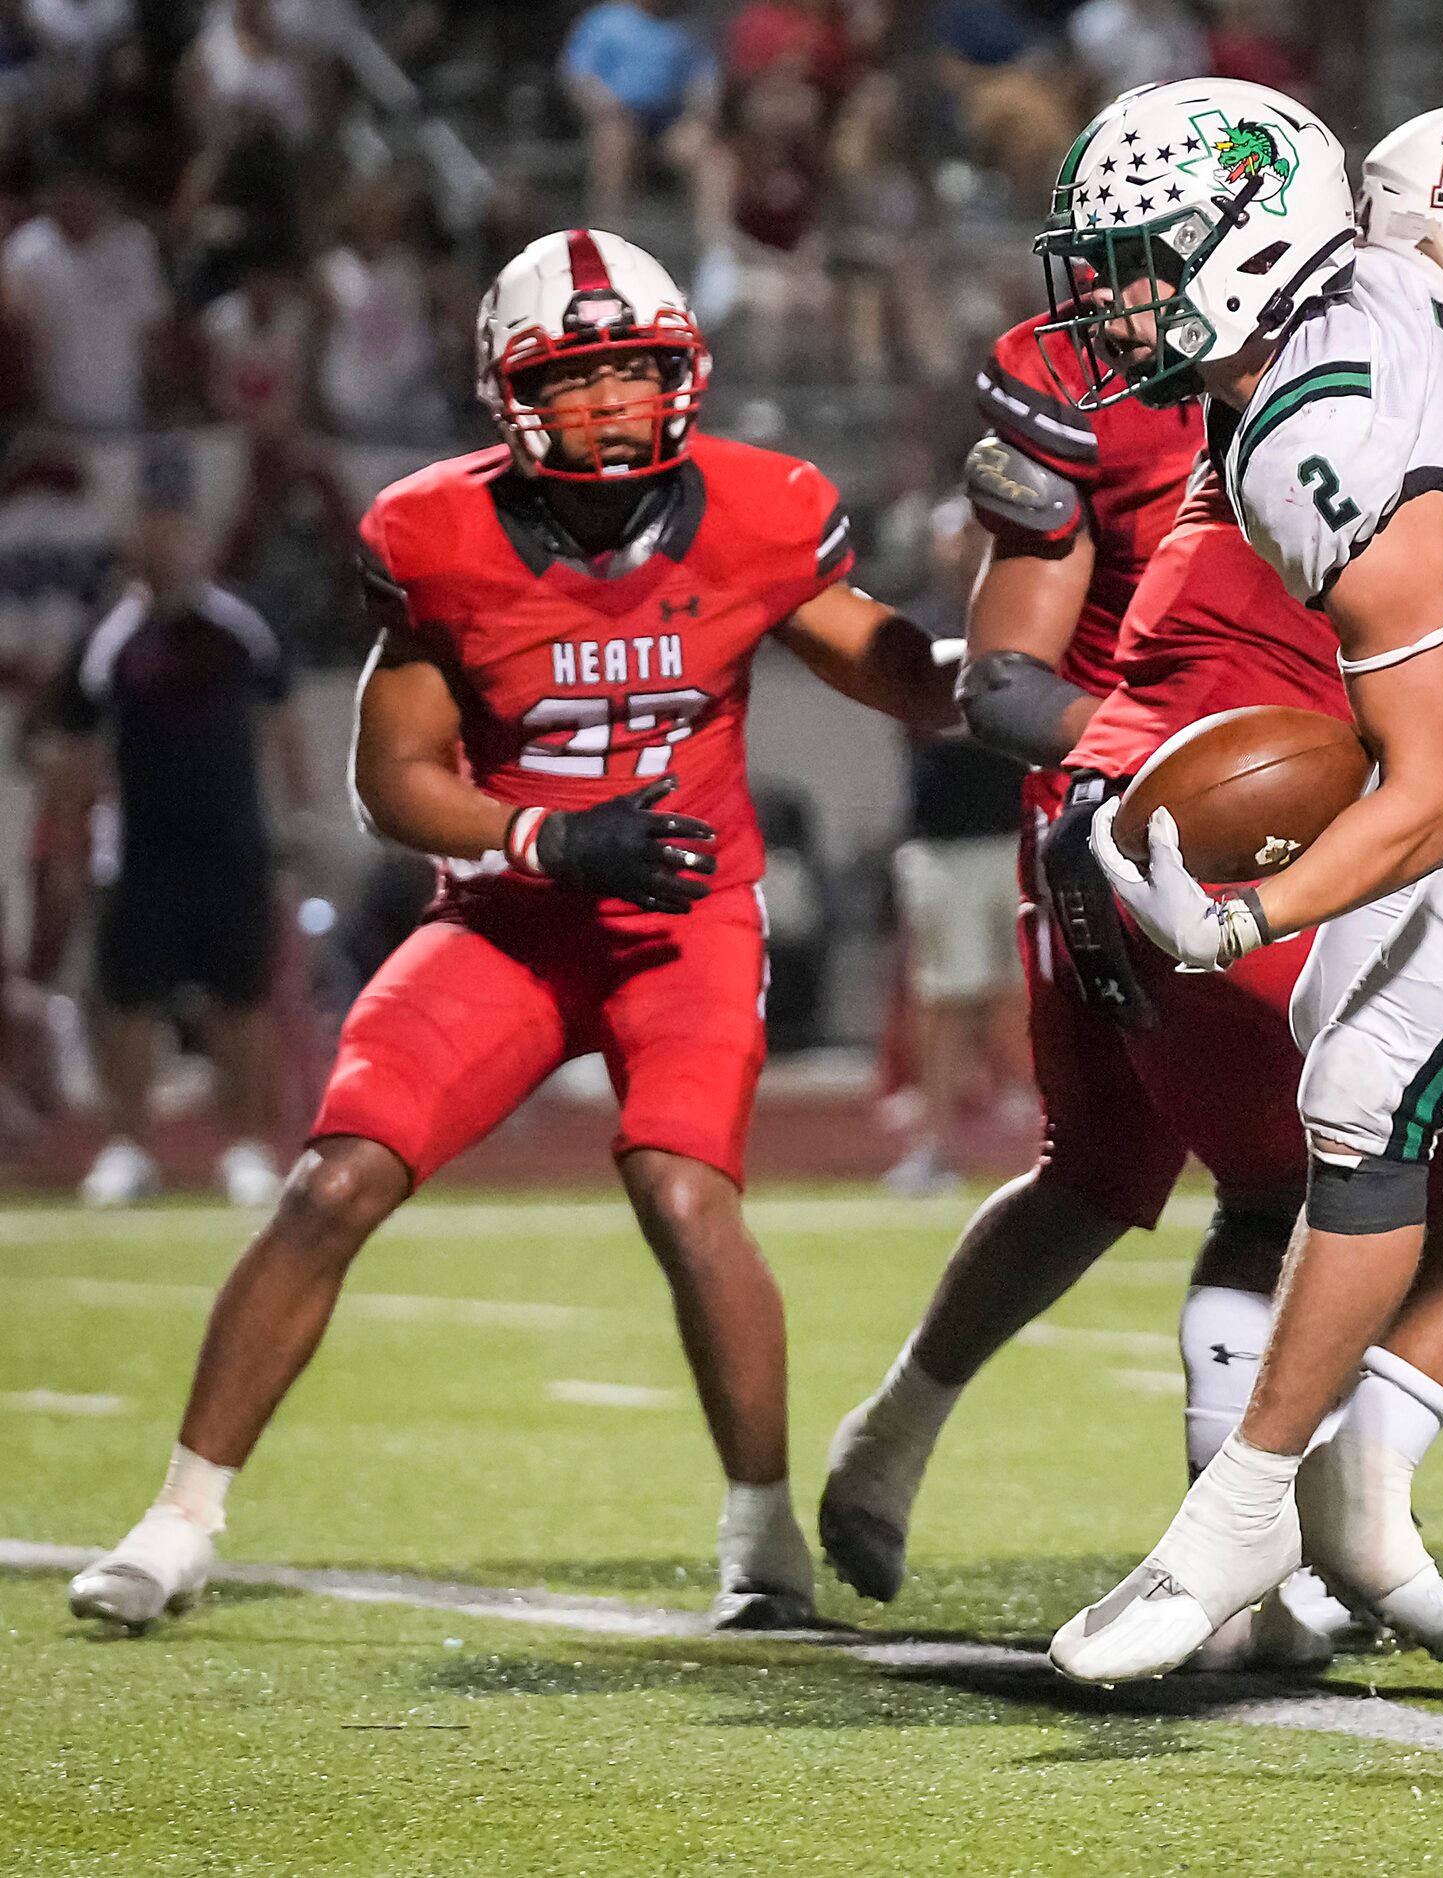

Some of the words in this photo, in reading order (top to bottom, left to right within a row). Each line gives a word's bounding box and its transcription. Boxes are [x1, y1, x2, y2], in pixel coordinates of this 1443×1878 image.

[1297, 454, 1361, 533] 2
[552, 634, 683, 685] HEATH
[519, 687, 711, 778] 27
